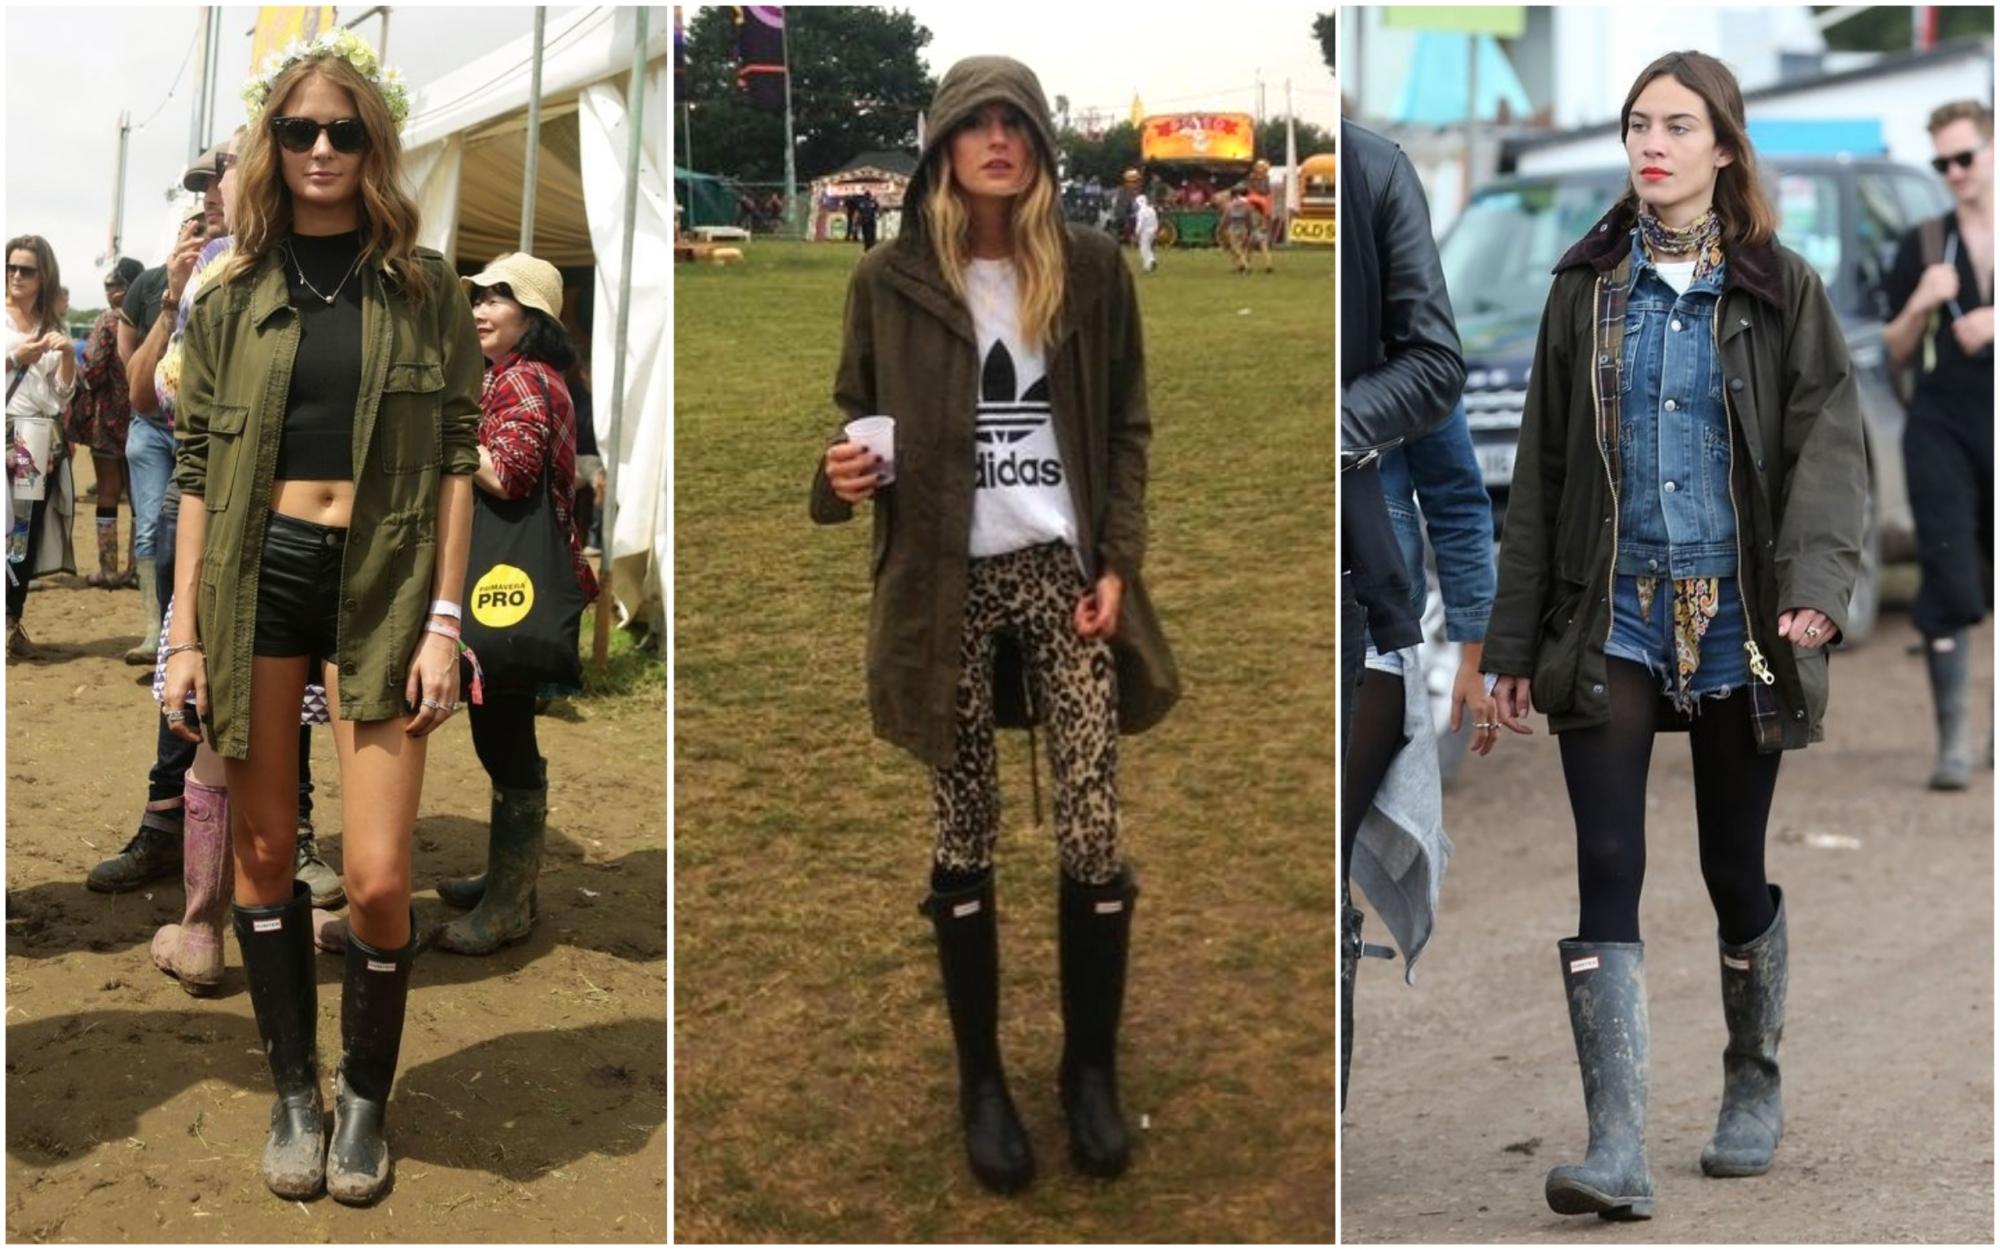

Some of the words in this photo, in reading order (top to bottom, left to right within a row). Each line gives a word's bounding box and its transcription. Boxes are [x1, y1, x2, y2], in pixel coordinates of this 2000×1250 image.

[1293, 223, 1323, 237] OLD
[976, 451, 1062, 488] didas
[477, 590, 526, 609] PRO
